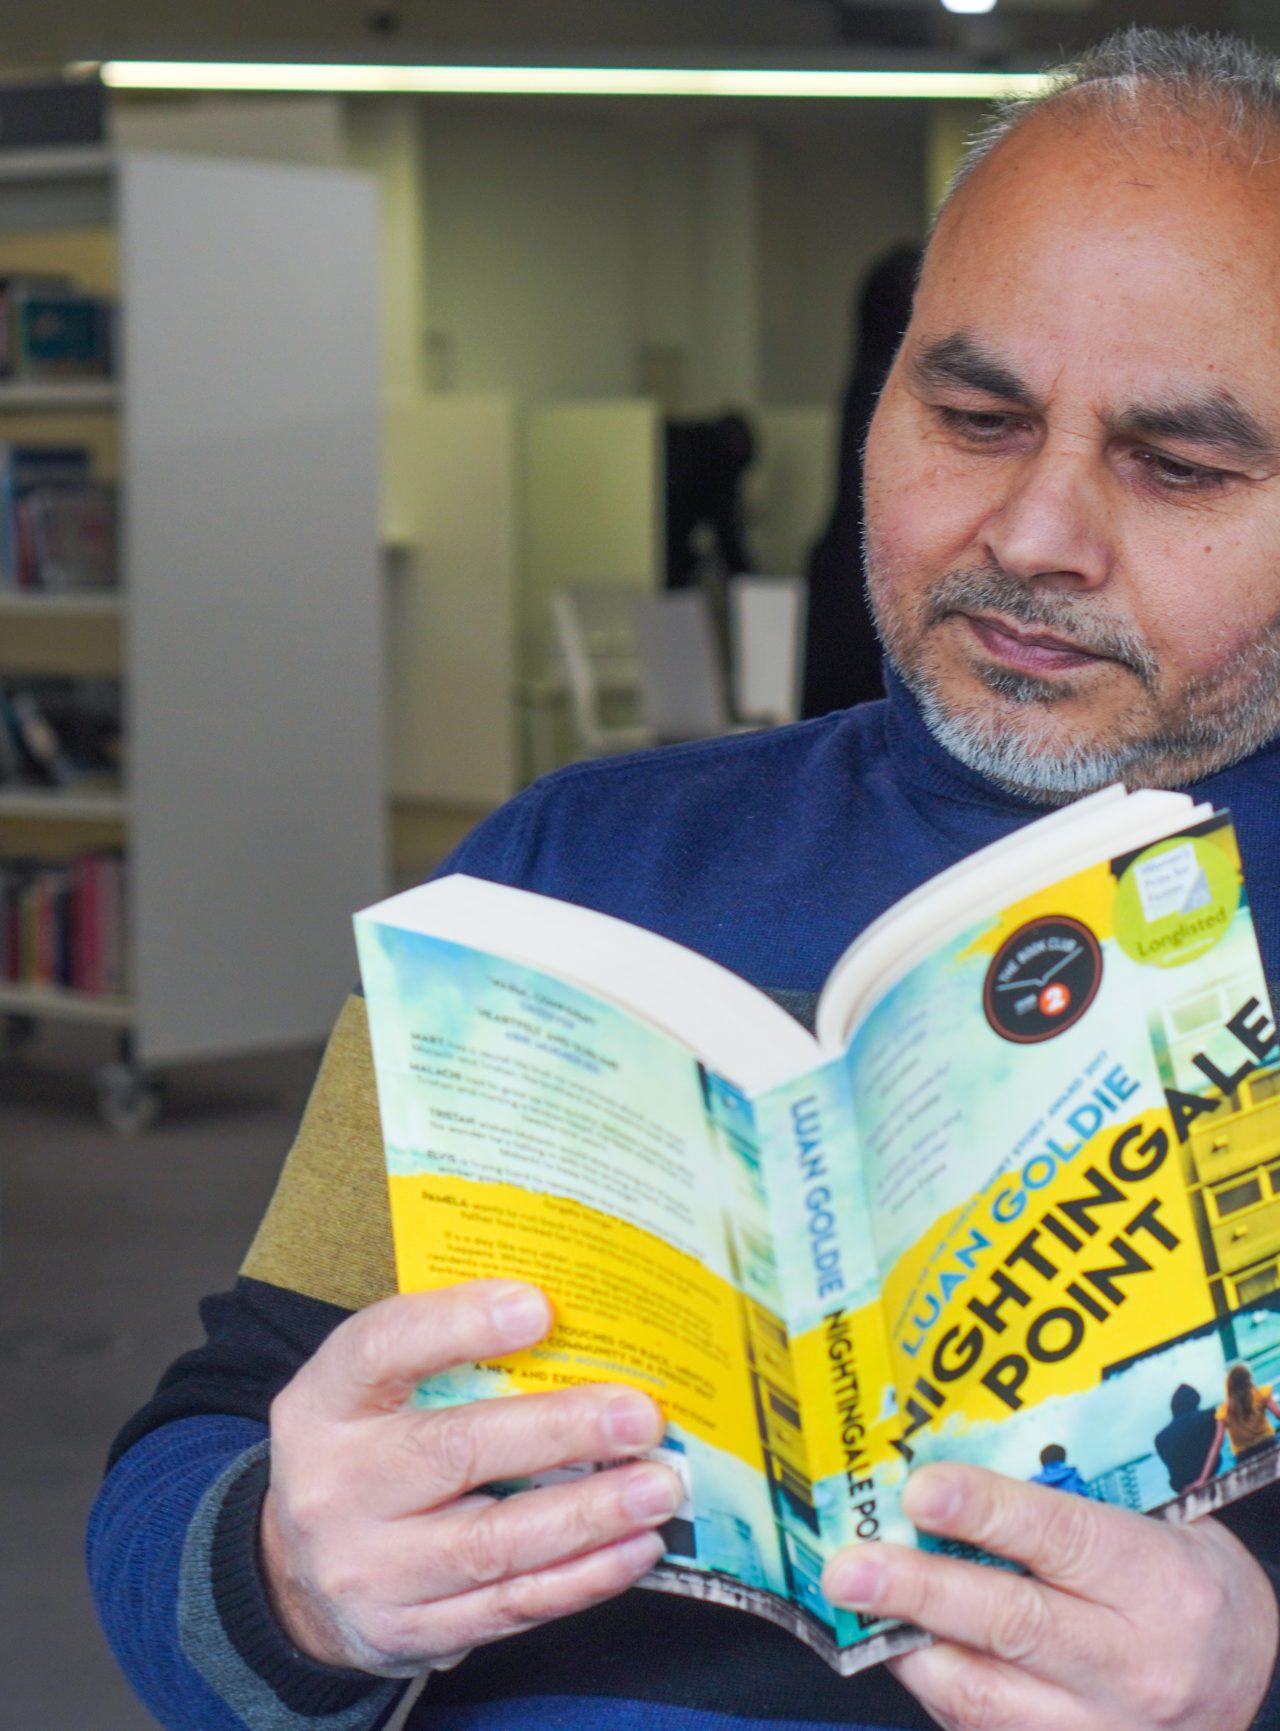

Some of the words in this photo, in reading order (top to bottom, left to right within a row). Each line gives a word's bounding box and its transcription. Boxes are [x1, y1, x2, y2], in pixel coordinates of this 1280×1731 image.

[997, 959, 1020, 984] THE
[1016, 938, 1047, 966] BOOK
[1046, 935, 1078, 954] CLUB
[1136, 905, 1227, 957] Longlisted
[1045, 985, 1067, 1014] 2
[790, 1094, 828, 1183] LUAN
[421, 1188, 468, 1208] PAMELA
[888, 996, 1277, 1464] NIGHTINGALE
[901, 1226, 993, 1359] LUAN
[991, 1063, 1141, 1223] GOLDIE
[804, 1186, 847, 1300] GOLDIE
[980, 1196, 1182, 1412] POINT
[485, 1364, 515, 1377] NEW
[520, 1370, 549, 1384] AND
[823, 1307, 874, 1497] NIGHTINGALE
